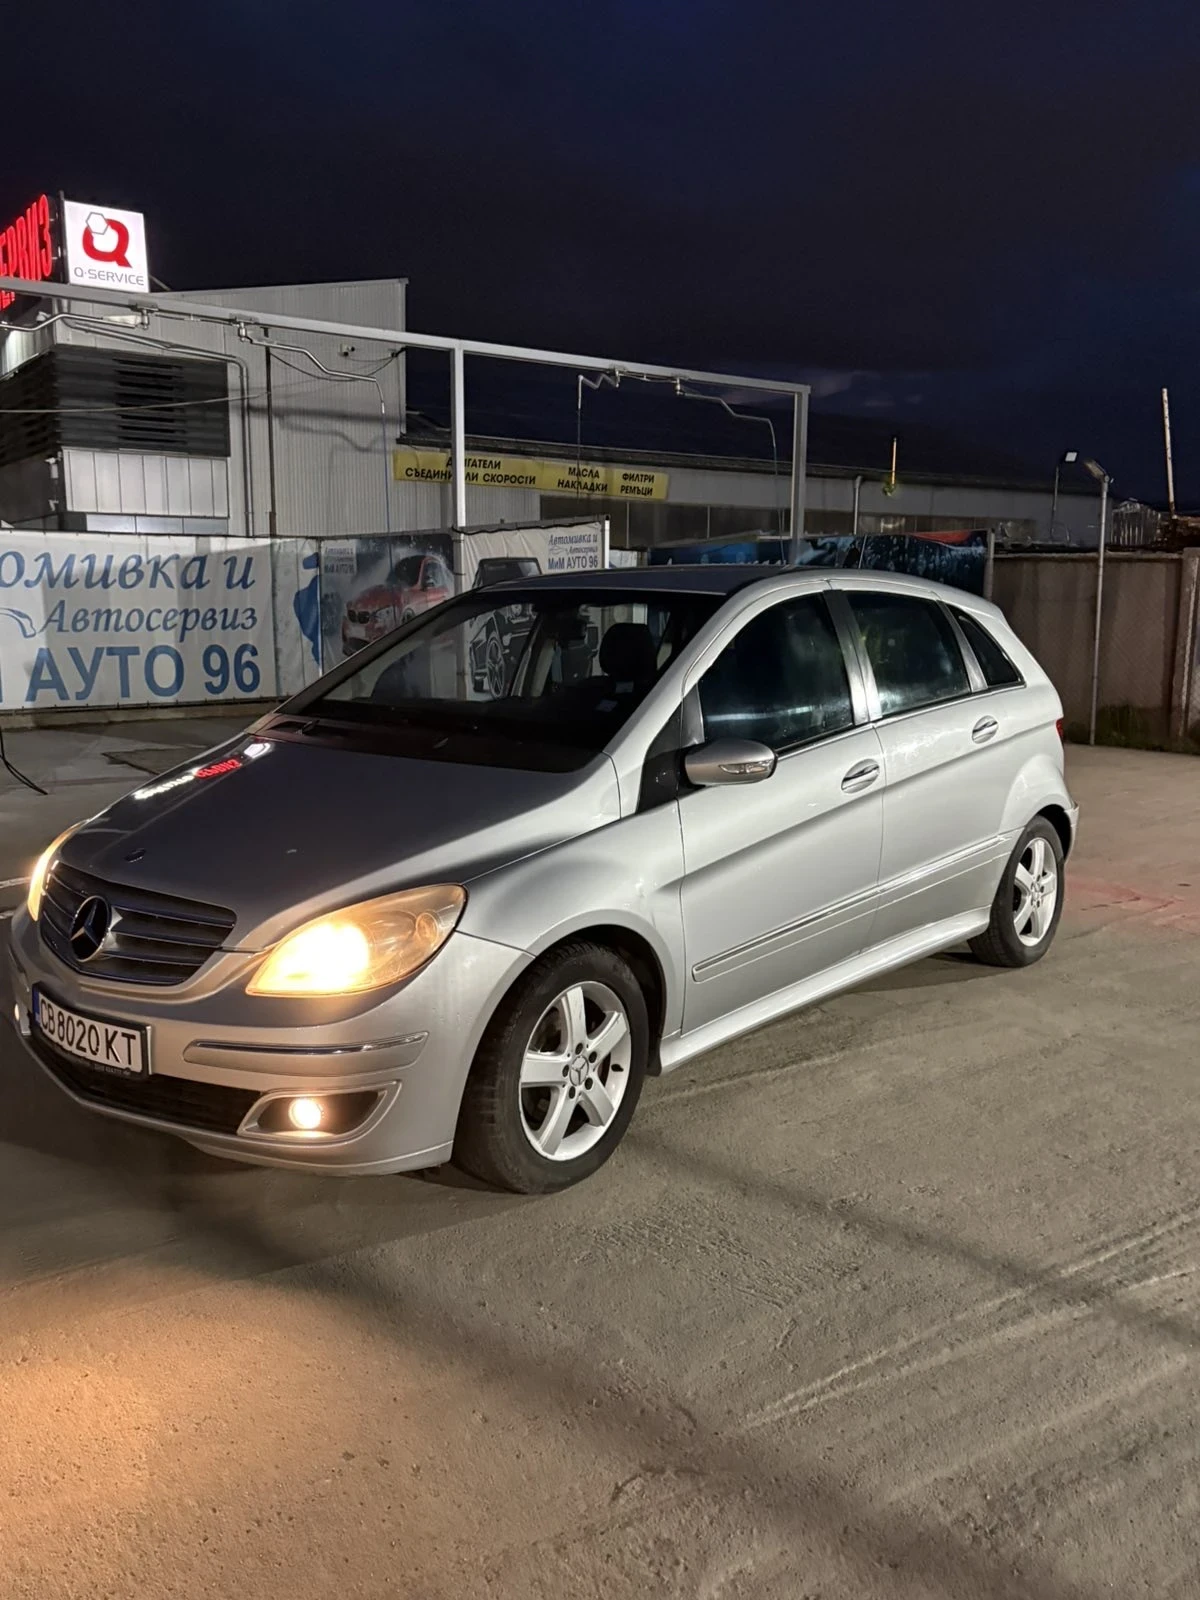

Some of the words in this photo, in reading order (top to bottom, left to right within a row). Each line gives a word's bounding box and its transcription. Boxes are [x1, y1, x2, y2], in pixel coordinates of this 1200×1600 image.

[482, 473, 537, 485] СКОРОСТИ
[568, 467, 600, 479] МАСЛА
[622, 473, 655, 483] ФИЛТРИ
[557, 479, 608, 492] НАКЛАДКИ
[620, 485, 653, 496] РЕМЪЦИ
[567, 556, 587, 569] АУТО
[588, 555, 598, 568] 96
[223, 556, 256, 589] и
[40, 600, 257, 642] Автосервиз
[25, 645, 185, 702] АУТО
[202, 643, 261, 695] 96
